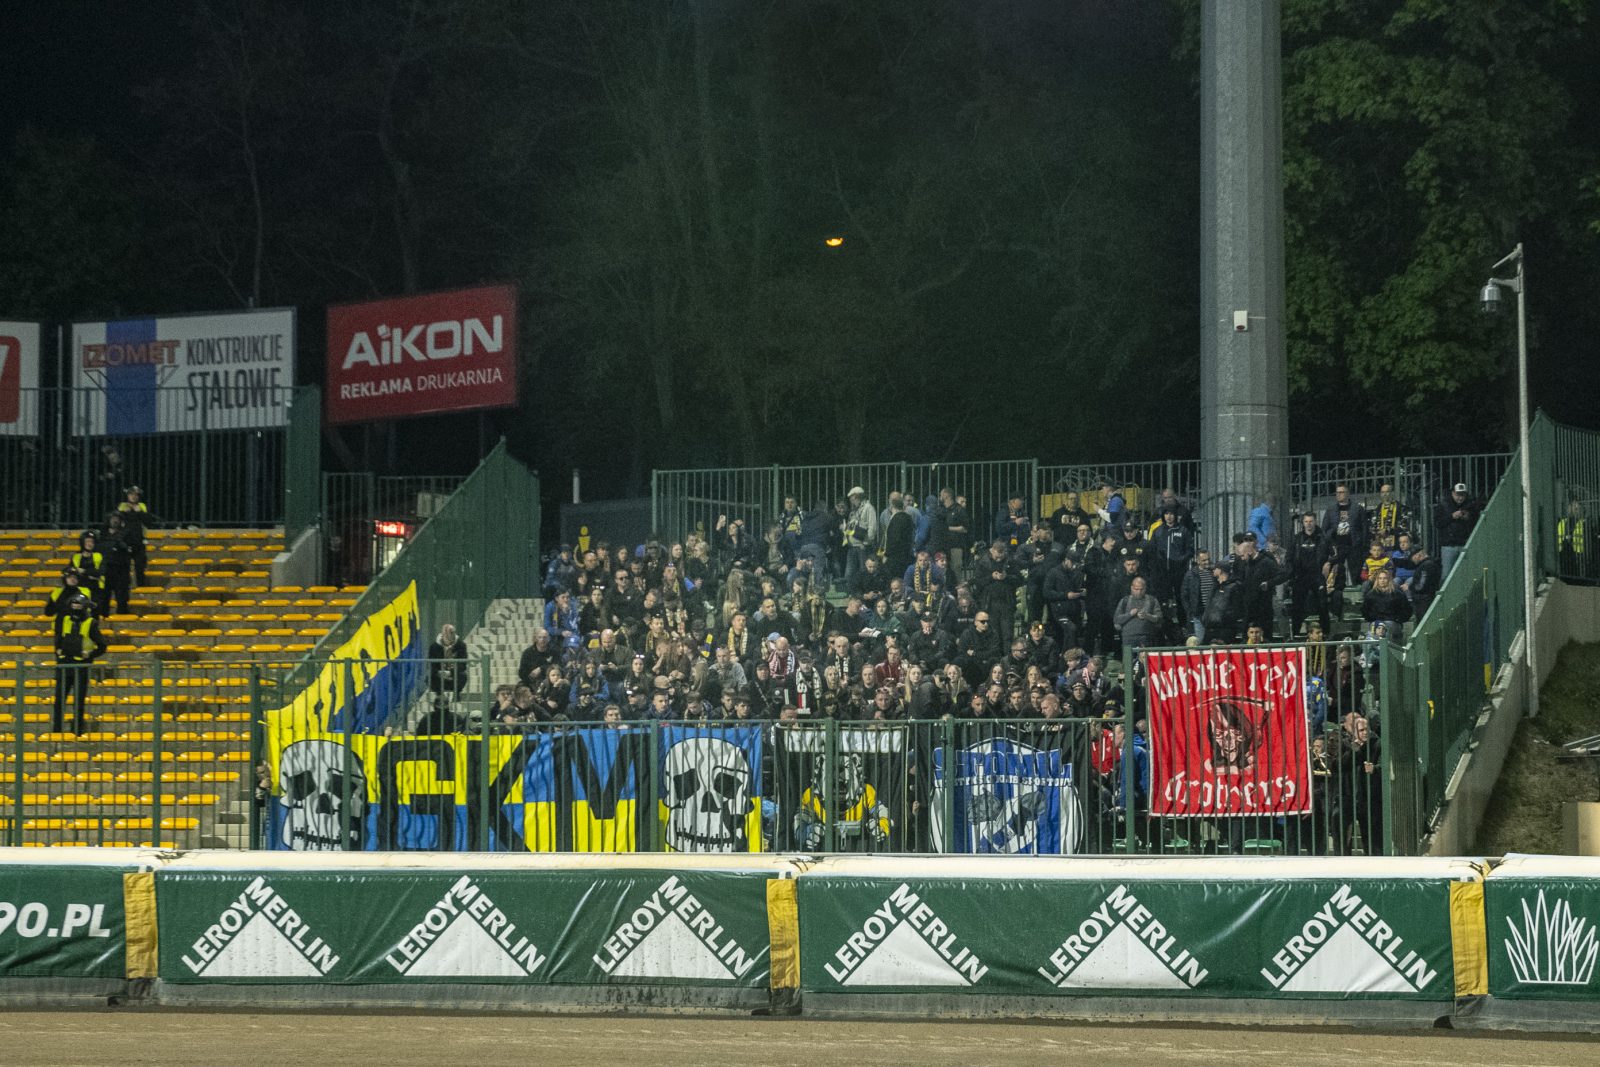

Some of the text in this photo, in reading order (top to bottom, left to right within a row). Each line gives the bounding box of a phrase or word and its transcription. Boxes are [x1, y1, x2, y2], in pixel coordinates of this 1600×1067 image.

[187, 334, 282, 366] KONSTRUKCJE
[187, 367, 281, 411] STALOWE
[341, 368, 502, 399] REKLAMA DRUKARNIA
[379, 734, 652, 852] GKM
[181, 876, 340, 974] LEROY MERLIN
[385, 875, 546, 973] LEROY MERLIN
[592, 875, 753, 977] LEROY MERLIN
[824, 882, 989, 983] LEROY MERLIN
[1038, 884, 1208, 988] LEROY MERLIN
[1260, 884, 1437, 990] LEROY MERLIN
